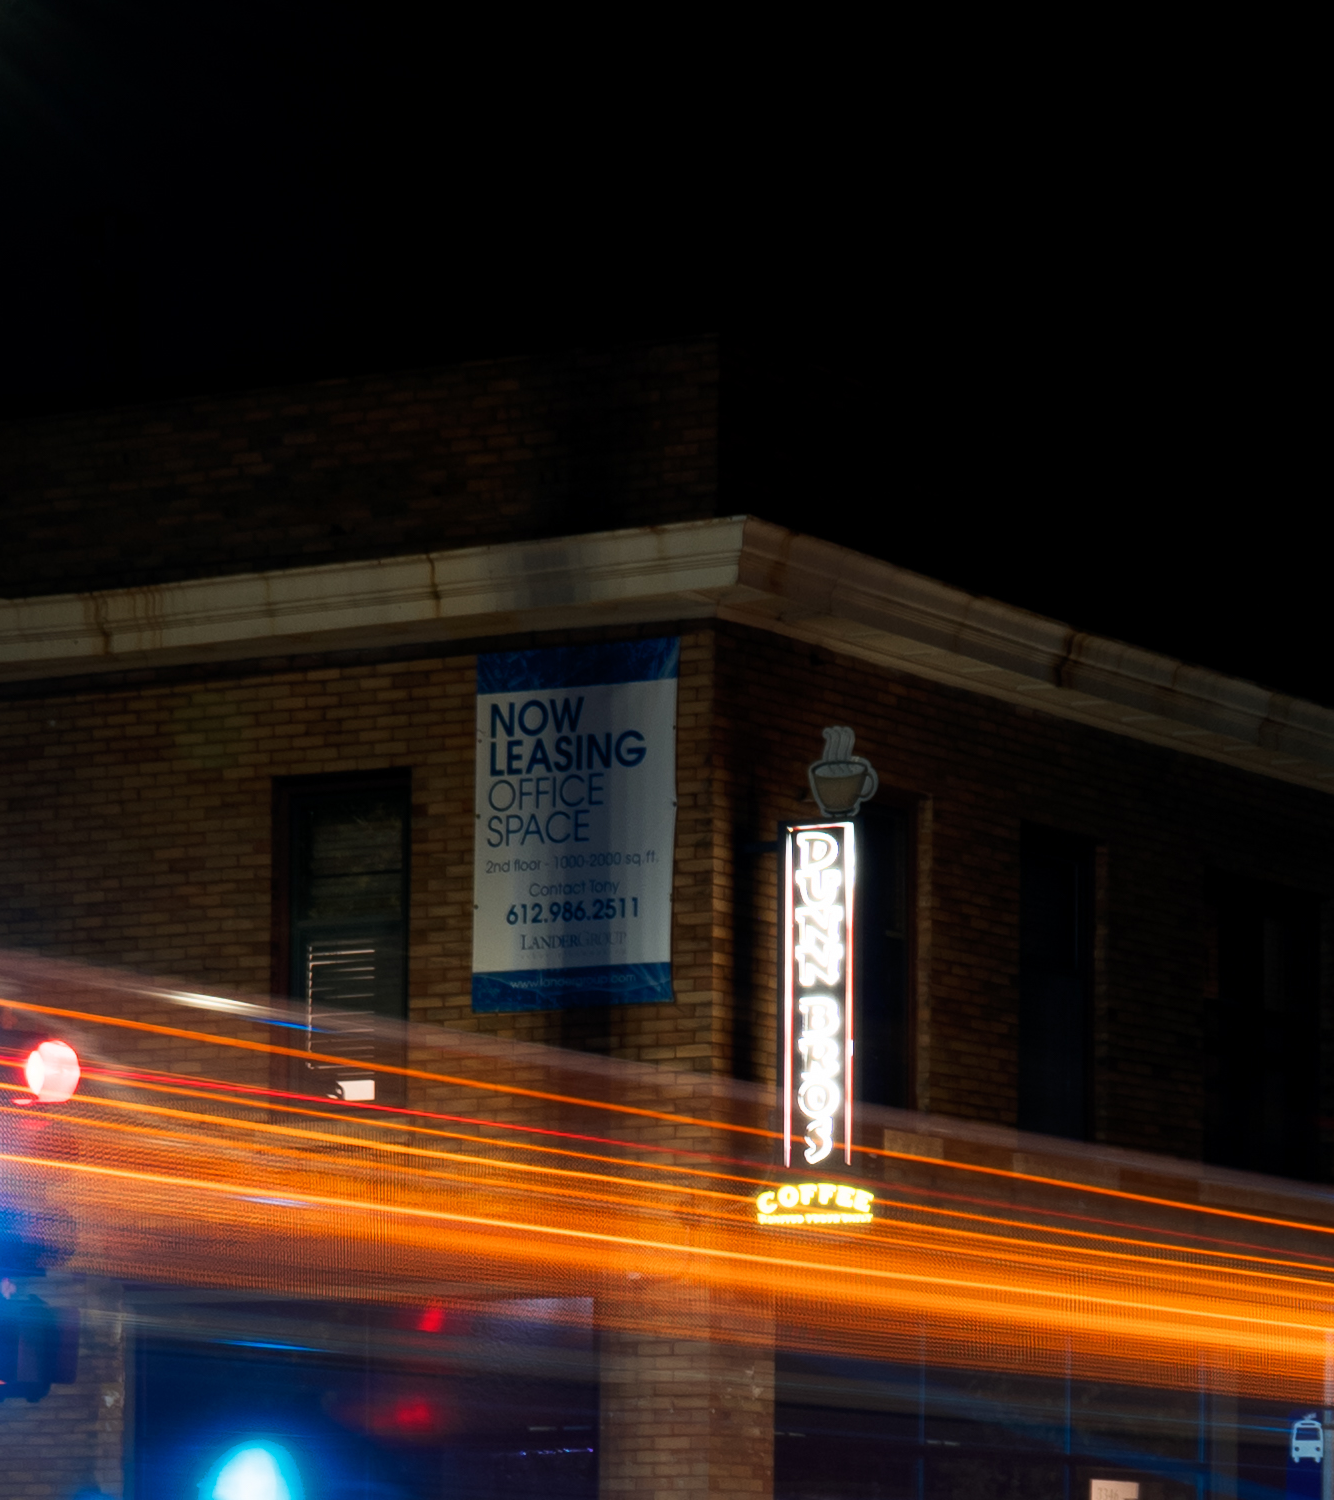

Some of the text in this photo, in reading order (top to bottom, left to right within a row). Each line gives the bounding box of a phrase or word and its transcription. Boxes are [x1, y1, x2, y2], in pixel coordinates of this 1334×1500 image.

[490, 696, 585, 739] NOW
[489, 730, 647, 777] LEASING
[488, 772, 604, 812] OFFICE
[486, 809, 590, 848] SPACE
[485, 860, 511, 874] 2nd
[514, 858, 541, 872] floor
[554, 851, 621, 870] 1000-2000
[529, 878, 621, 898] Contact Tony
[506, 897, 639, 926] 612.986.2511
[510, 974, 637, 989] www.landergroup.com
[795, 831, 844, 1165] DUNN BROS
[756, 1183, 874, 1214] COFFEE
